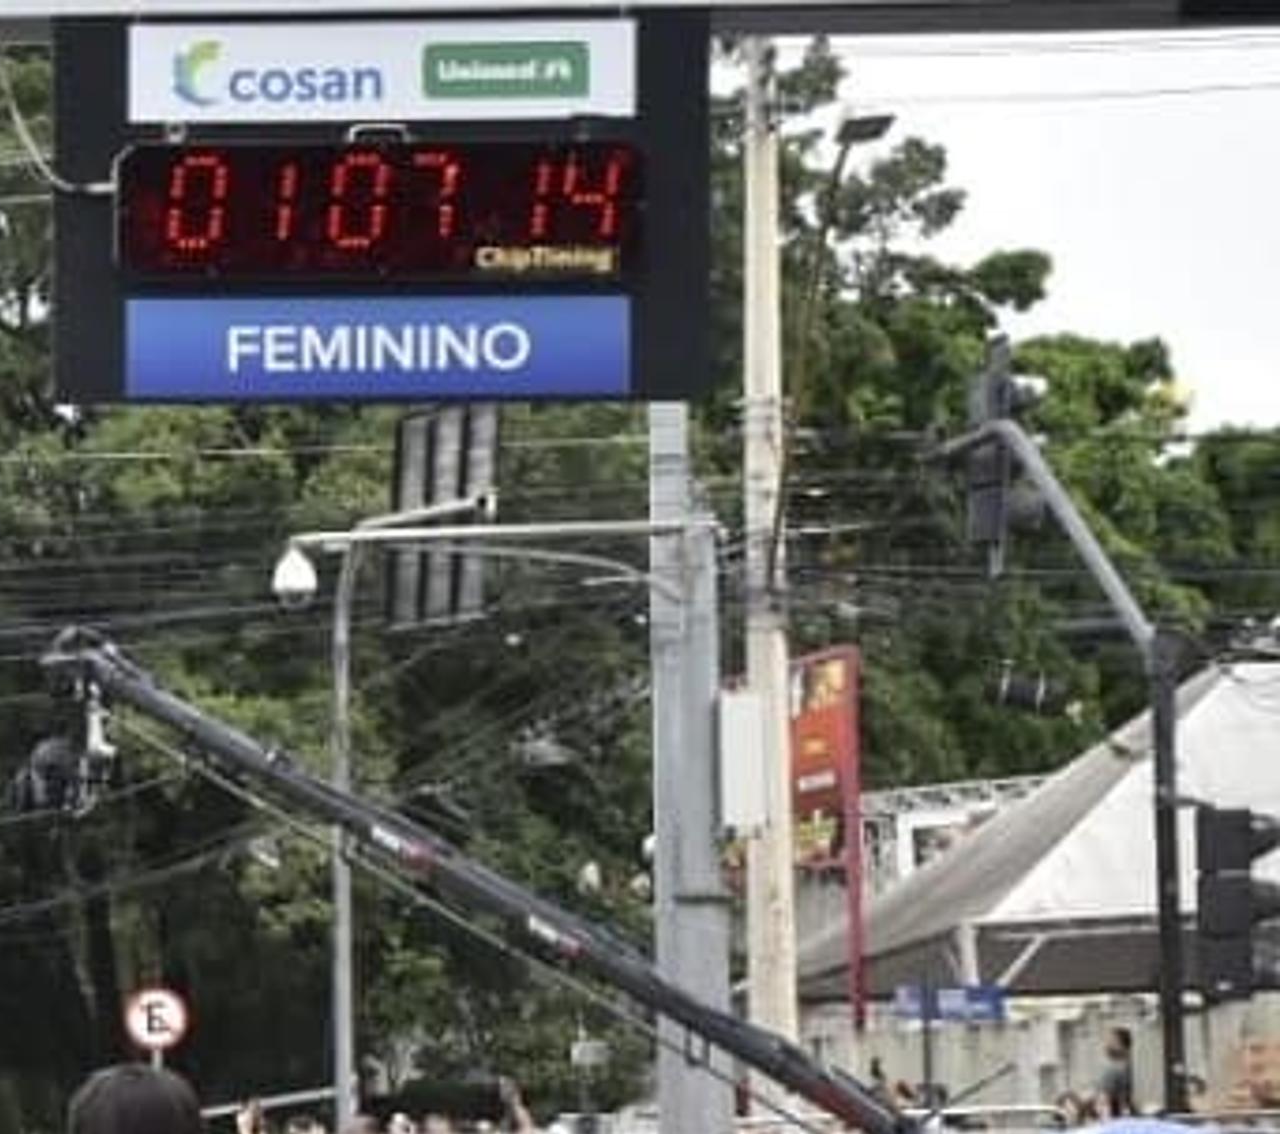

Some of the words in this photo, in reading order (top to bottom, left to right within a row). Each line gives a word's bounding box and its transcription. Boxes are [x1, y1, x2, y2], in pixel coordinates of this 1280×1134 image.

[229, 66, 383, 103] cosan
[438, 60, 535, 82] Unimed
[476, 246, 612, 272] ChipTiming
[228, 325, 530, 371] FEMININO
